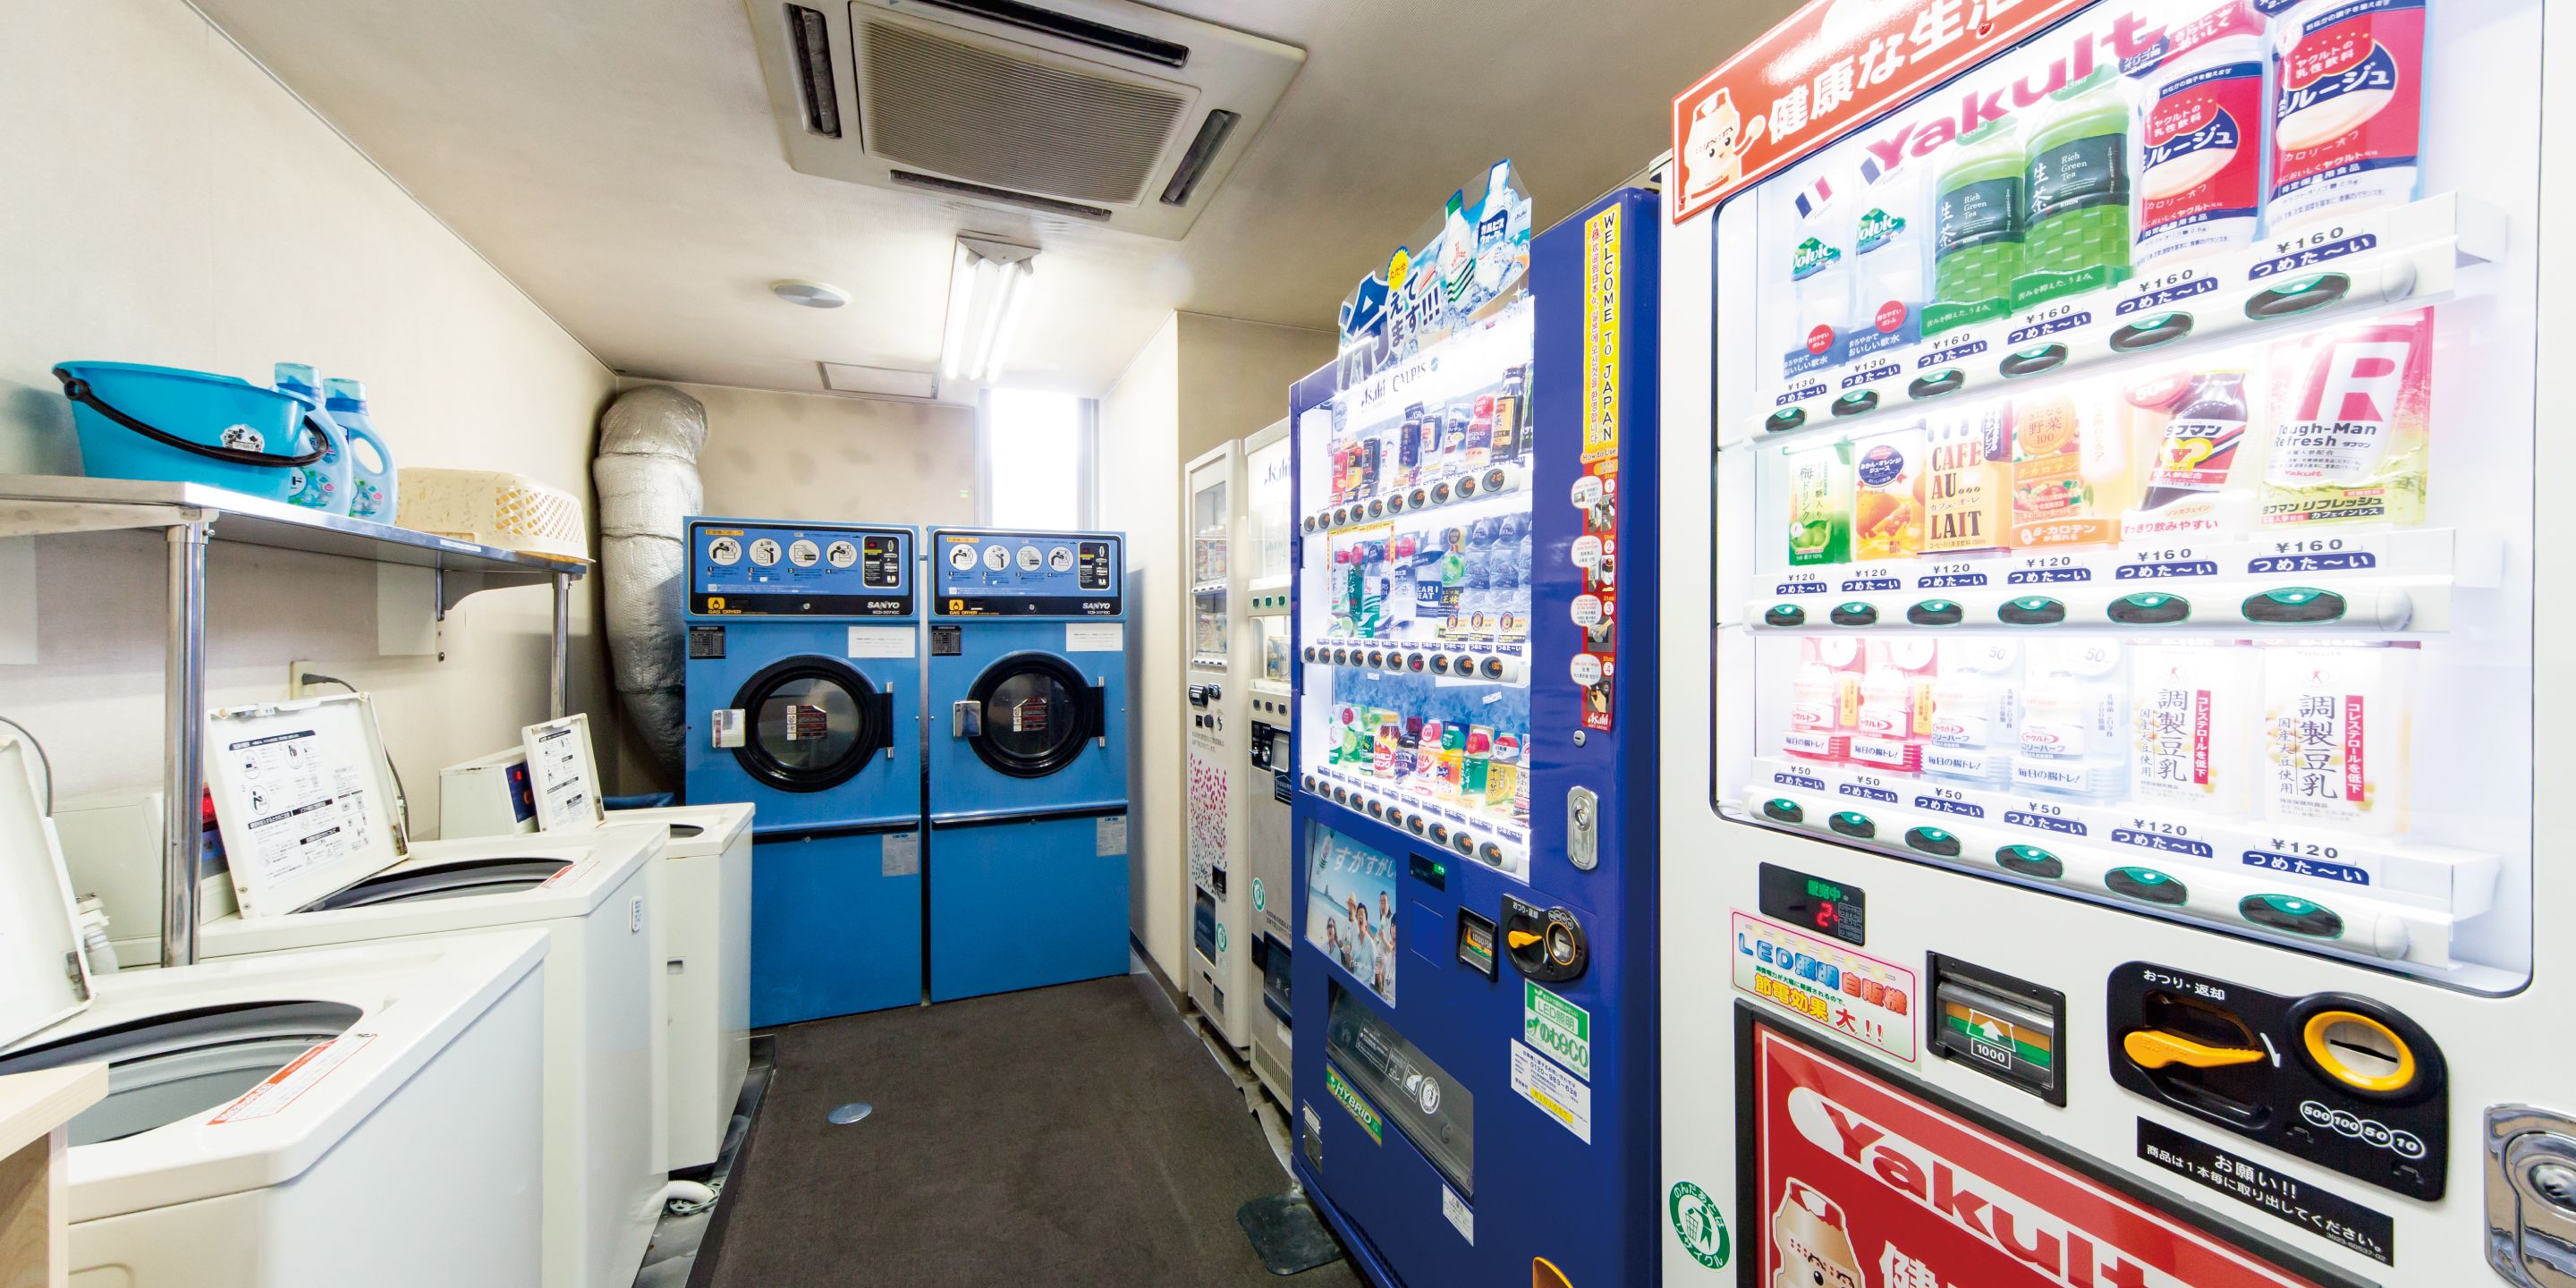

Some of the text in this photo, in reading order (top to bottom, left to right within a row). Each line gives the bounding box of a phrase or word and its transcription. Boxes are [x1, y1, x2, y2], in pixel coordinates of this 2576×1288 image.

[2296, 41, 2353, 68] ヤクルトの
[2295, 50, 2354, 79] 乳性飲料
[1867, 12, 2169, 171] Yakult
[2154, 113, 2202, 138] 乳性飲料
[2155, 106, 2201, 128] ヤクルトの
[2284, 131, 2360, 163] カロリーオフ
[2061, 160, 2088, 173] Green
[2062, 152, 2080, 164] Rich
[2061, 171, 2076, 181] Tea
[2032, 163, 2053, 215] 生茶
[2147, 183, 2207, 210] カロリーオフ
[1963, 200, 1987, 211] Green
[1964, 193, 1980, 203] Rich
[1963, 209, 1977, 219] Tea
[1939, 202, 1956, 246] 生茶
[2276, 226, 2343, 253] ¥160
[2140, 269, 2193, 292] ¥160
[2026, 305, 2071, 324] ¥160
[1602, 212, 1615, 441] WELCOME TO JAPAN
[1933, 333, 1970, 350] ¥160
[1854, 358, 1885, 372] ¥130
[1788, 377, 1816, 391] ¥130
[2029, 416, 2062, 435] 野菜
[2166, 425, 2222, 436] タフマン
[2278, 423, 2377, 435] Tough-Man
[2037, 434, 2054, 444] 100
[2275, 436, 2336, 447] Refresh
[1931, 473, 1956, 500] AU
[2167, 504, 2210, 516] ノンカフェイン
[2263, 497, 2384, 514] タフマン リフレッシュ
[2311, 508, 2379, 519] カフェインレス
[1931, 511, 1981, 540] LAIT
[1606, 542, 1612, 551] 2
[2275, 539, 2343, 553] ¥160
[2027, 556, 2071, 567] ¥120
[2138, 548, 2192, 562] ¥160
[1789, 573, 1815, 581] ¥120
[1856, 569, 1886, 578] ¥120
[1934, 564, 1970, 573] ¥120
[867, 601, 900, 609] SANYO
[1082, 602, 1110, 610] SANYO
[1606, 604, 1611, 613] 3
[1606, 665, 1611, 674] 4
[2140, 708, 2152, 778] 国産大豆使用
[2157, 688, 2189, 783] 調製豆乳
[2195, 697, 2209, 777] コレステロールを低下
[2277, 716, 2294, 794] 国産大豆使用
[2298, 694, 2339, 801] 調製豆乳
[2346, 704, 2362, 794] コレステロールを低下
[1791, 765, 1810, 775] ¥50
[1857, 775, 1880, 785] ¥50
[1935, 788, 1962, 800] ¥50
[2029, 802, 2061, 816] ¥50
[2133, 818, 2188, 836] ¥120
[2271, 838, 2339, 859] ¥120
[1808, 880, 1841, 901] 販売中
[1538, 1002, 1575, 1032] LED照明
[1976, 1043, 2005, 1063] 1000
[1336, 1080, 1372, 1125] HYBRID
[2303, 1106, 2418, 1150] 500 100 50 10
